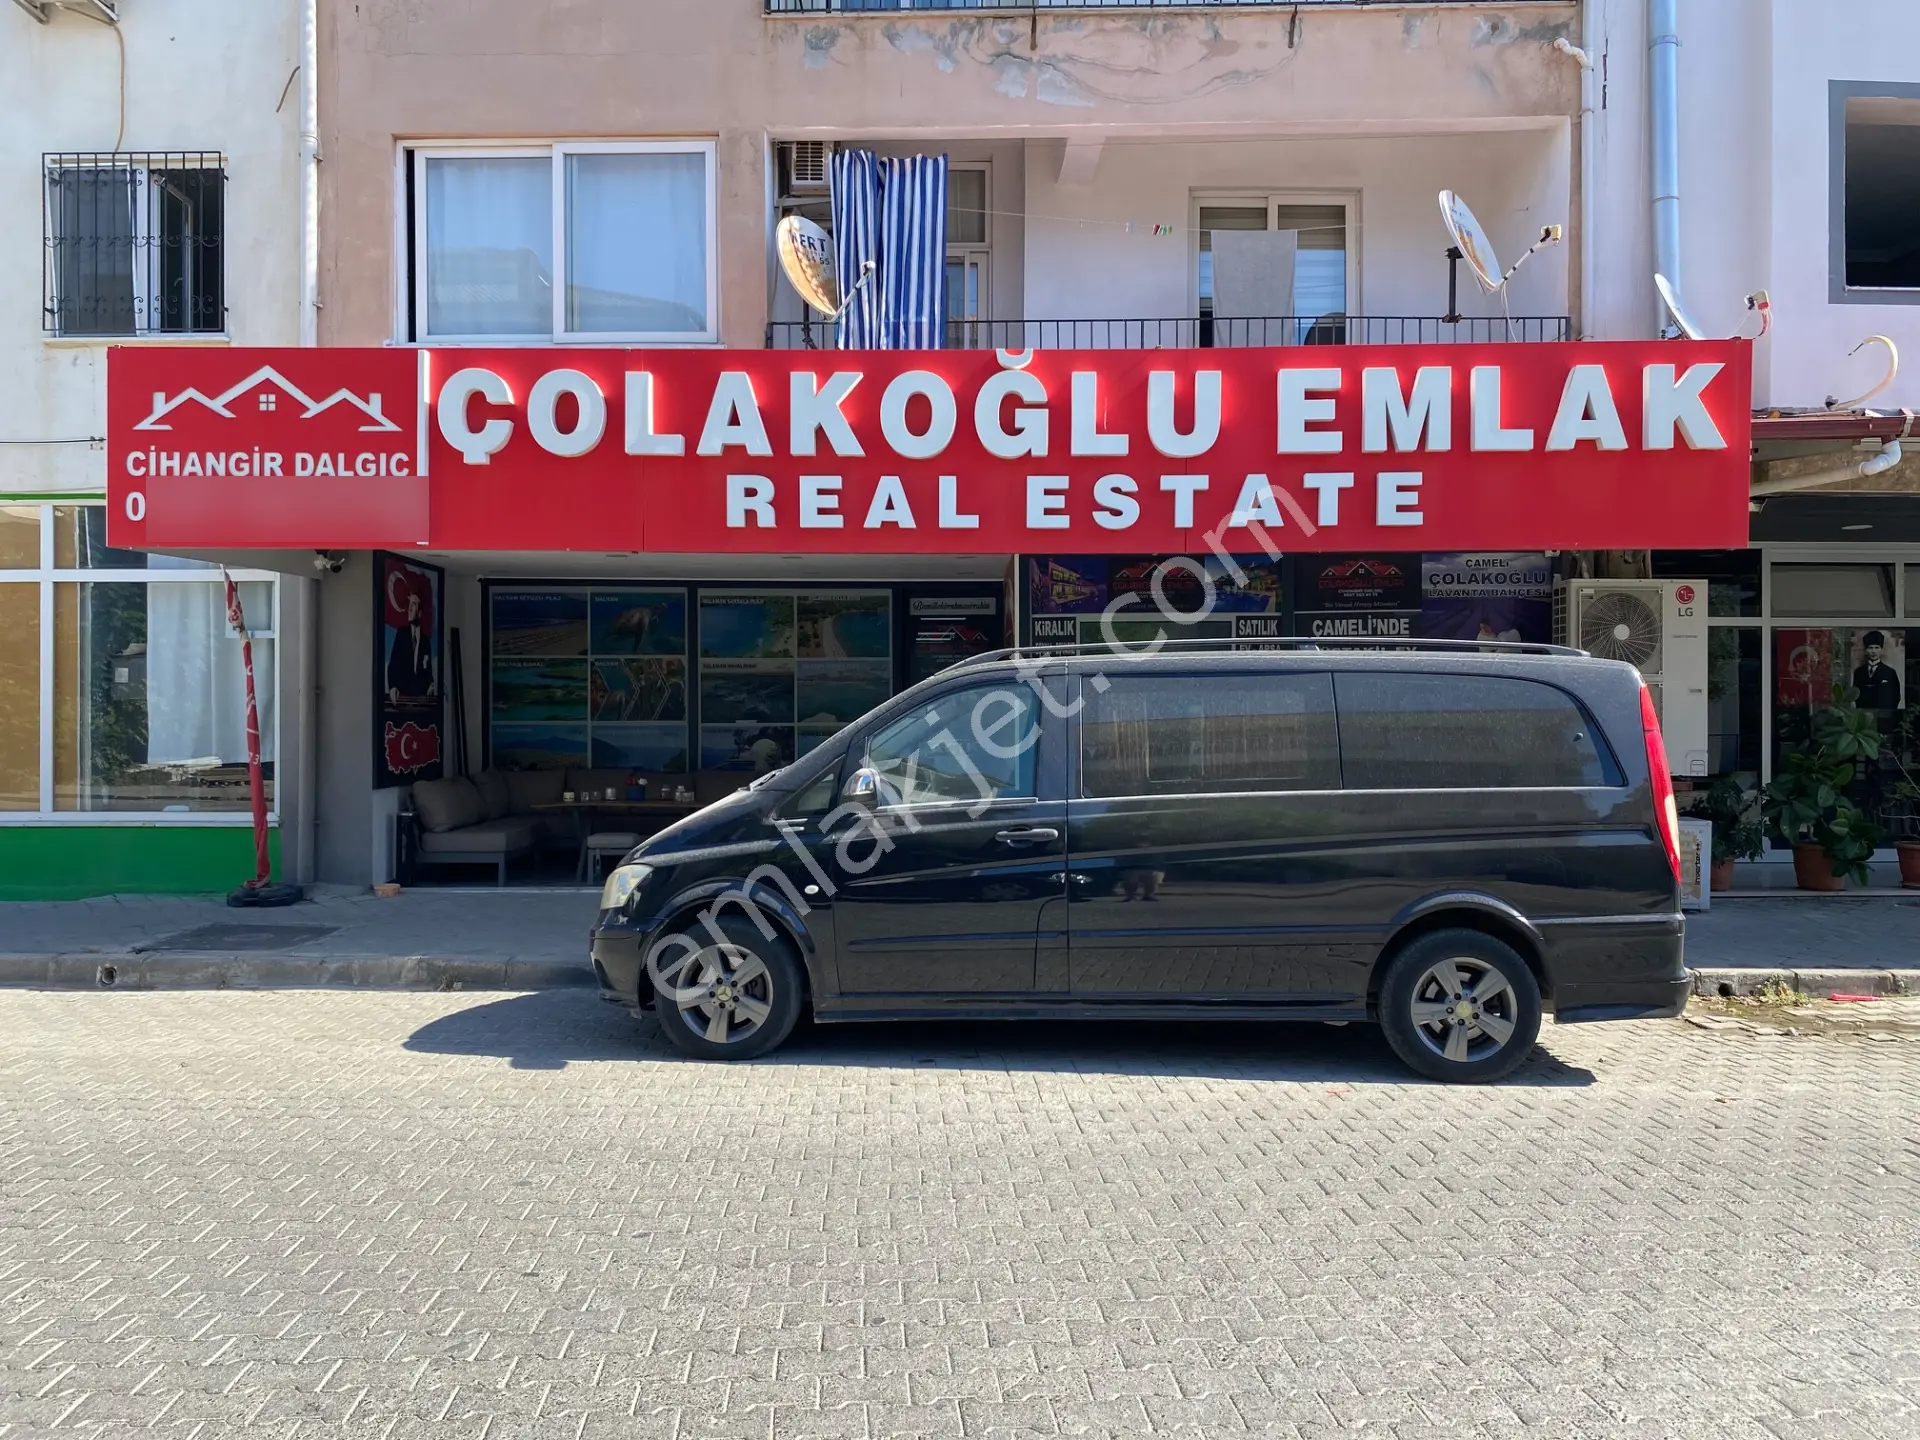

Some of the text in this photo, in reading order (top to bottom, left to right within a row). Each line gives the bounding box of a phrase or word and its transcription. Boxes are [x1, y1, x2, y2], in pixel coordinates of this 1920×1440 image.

[438, 349, 1727, 465] ÇOLAKOĞLU EMLAK
[126, 446, 283, 476] CİHANGİR
[726, 472, 1424, 529] REAL ESTATE
[1429, 570, 1546, 588] ÇOLAKOĞLU
[1429, 589, 1486, 597] LAVANTA
[1678, 608, 1694, 617] LG
[1239, 619, 1278, 636] SATILIK
